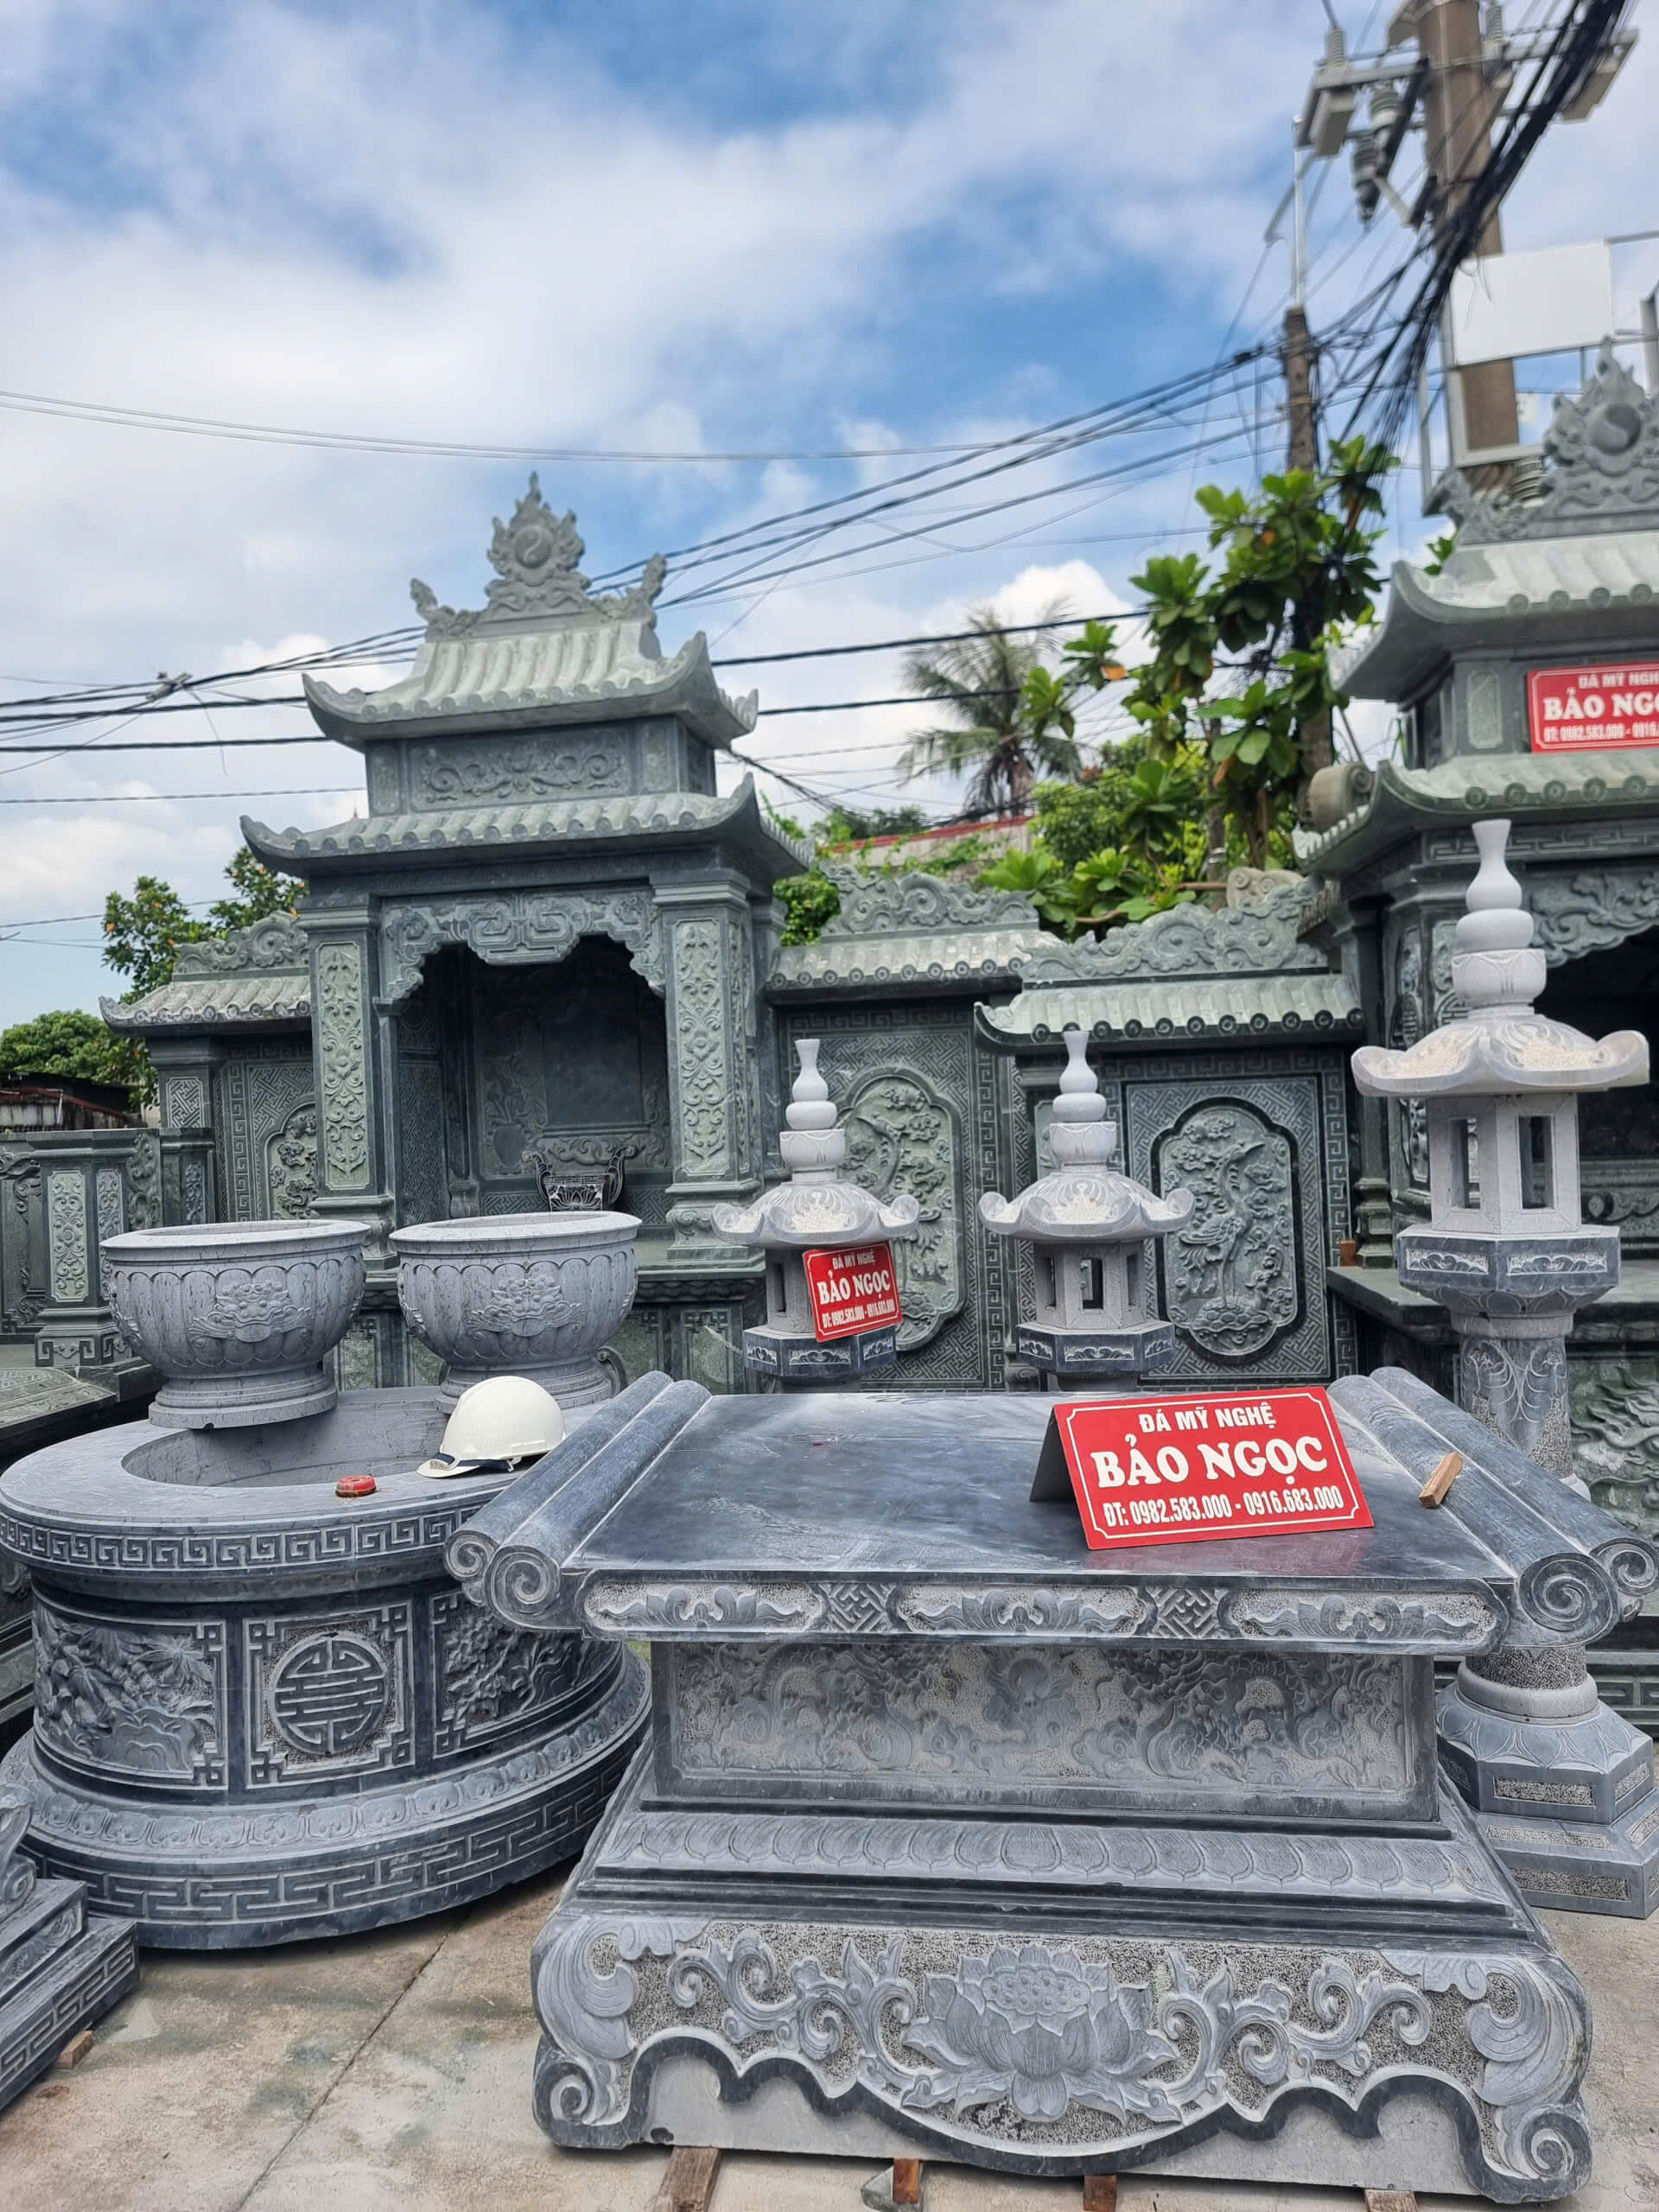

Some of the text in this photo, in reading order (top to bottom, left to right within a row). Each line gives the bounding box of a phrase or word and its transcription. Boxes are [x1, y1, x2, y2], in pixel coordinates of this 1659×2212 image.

[1542, 687, 1659, 721] BẢO NG
[817, 1270, 891, 1305] BẢO NGỌC
[1139, 1402, 1277, 1433] ĐÁ MỸ NGHỆ
[1090, 1433, 1328, 1488] BẢO NGỌC
[1103, 1502, 1129, 1528] ĐT:
[1130, 1494, 1232, 1526] 0982.583.000
[1243, 1485, 1344, 1516] 0916.683.000
